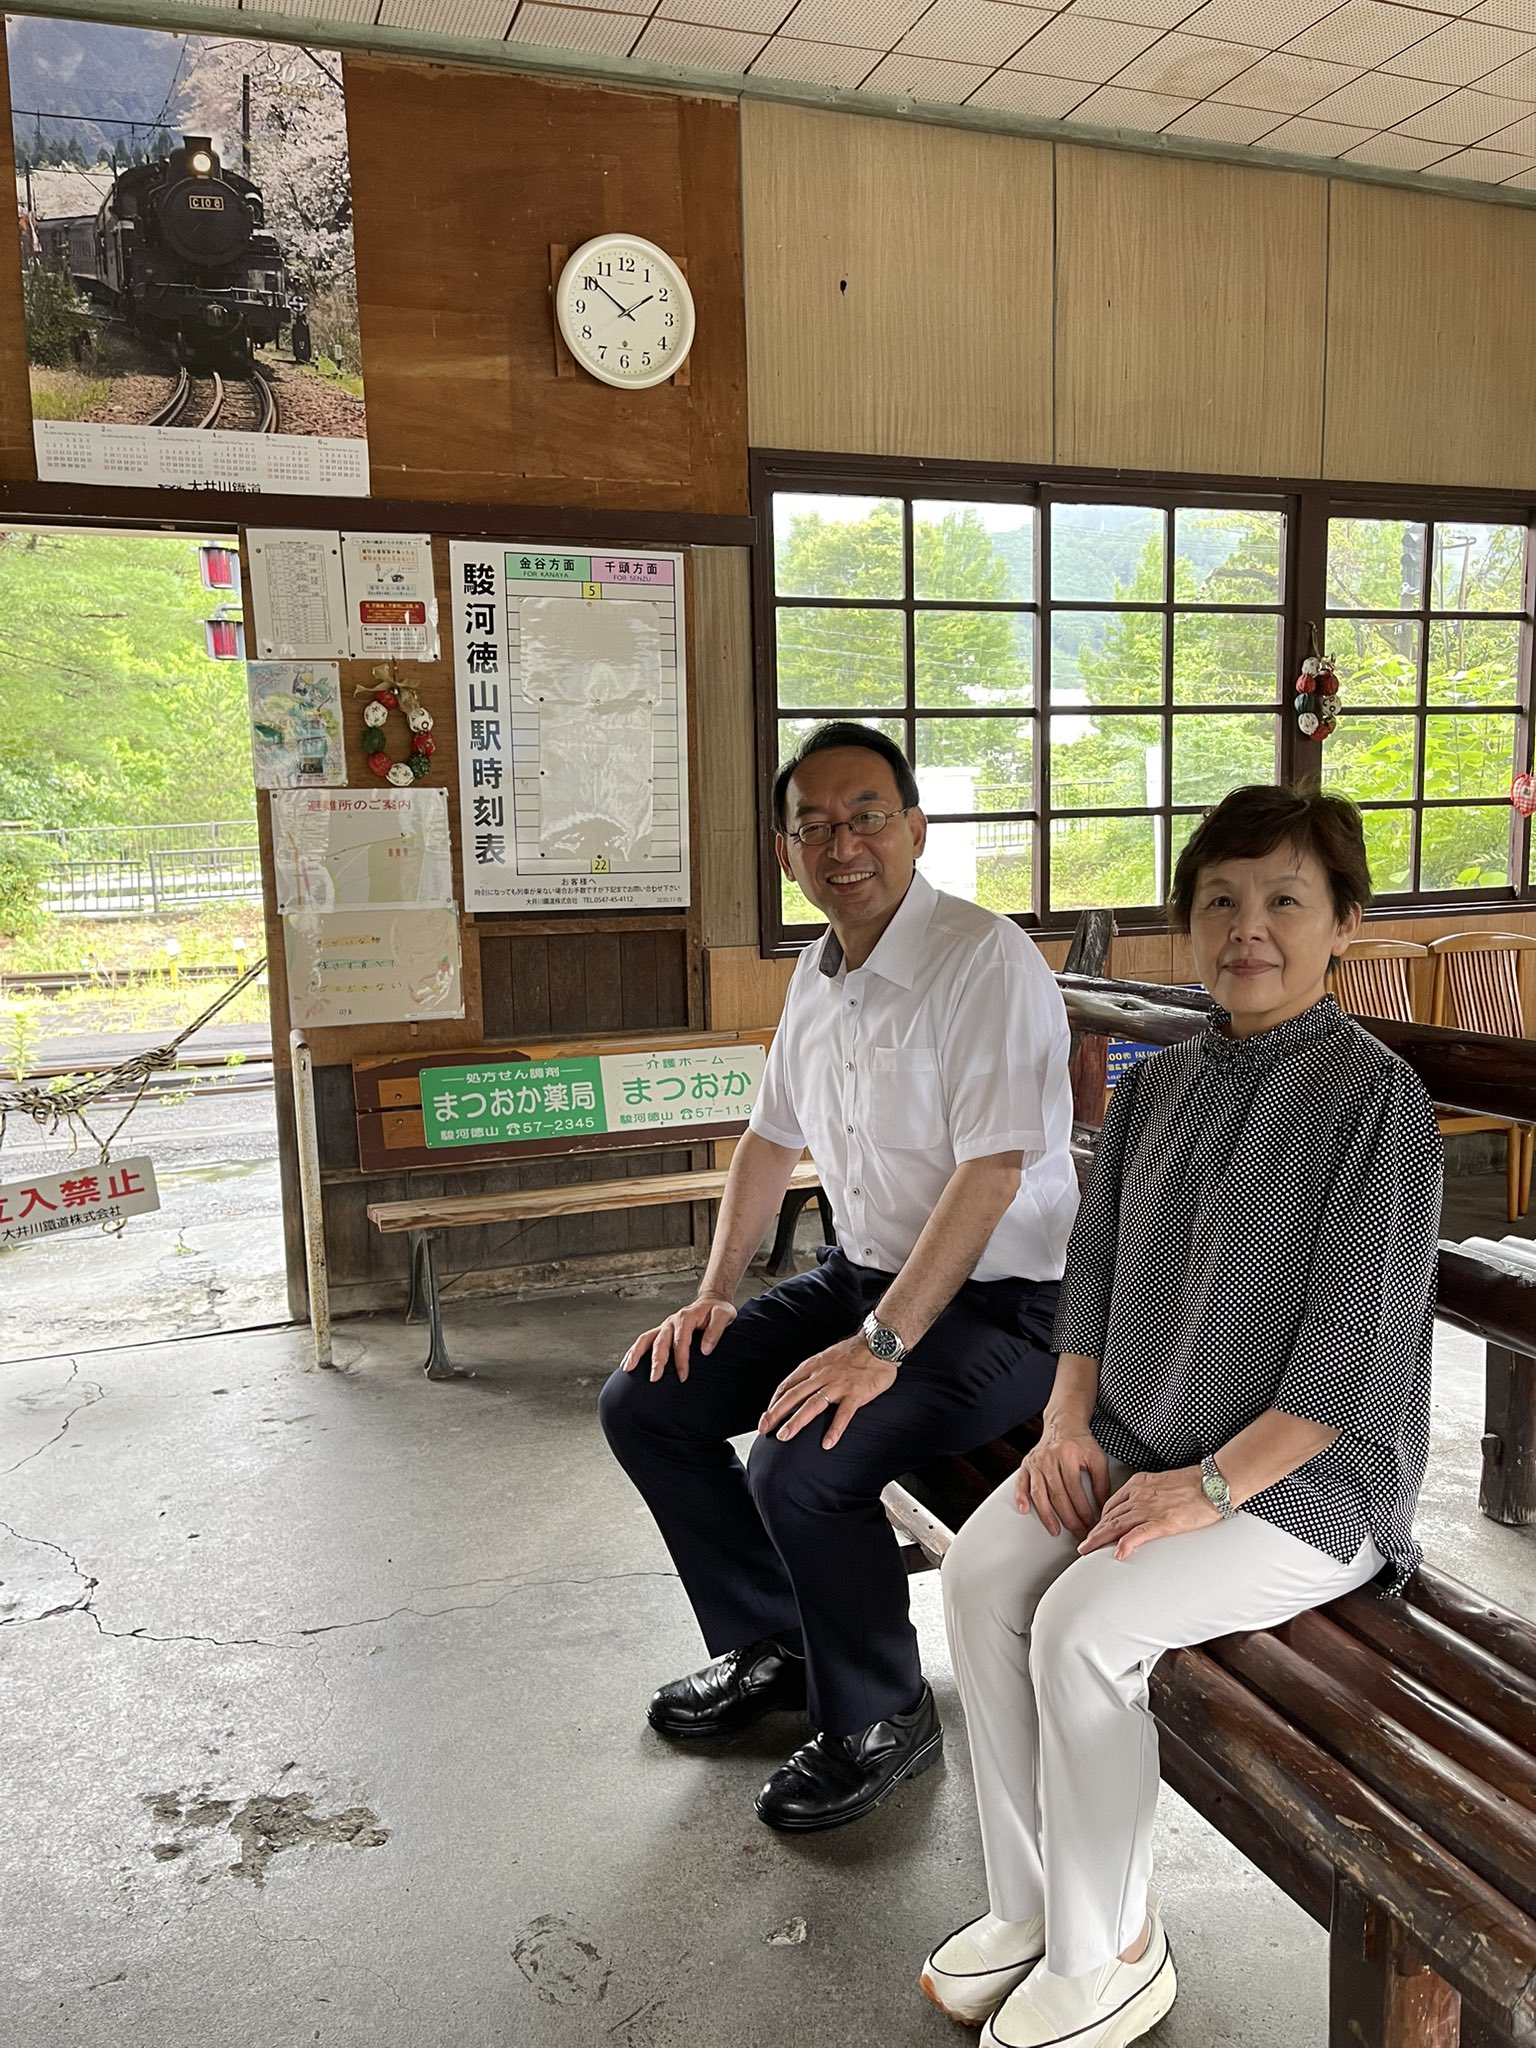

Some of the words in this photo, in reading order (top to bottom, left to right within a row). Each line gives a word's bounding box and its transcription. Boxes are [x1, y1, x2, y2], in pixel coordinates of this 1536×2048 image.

[597, 262, 612, 277] 11
[618, 257, 635, 272] 12
[644, 269, 650, 282] 1
[583, 276, 598, 291] 10
[659, 288, 668, 302] 2
[576, 300, 585, 313] 9
[665, 314, 673, 326] 3
[582, 326, 592, 339] 8
[657, 336, 667, 350] 4
[598, 346, 607, 360] 7
[642, 352, 651, 365] 5
[620, 355, 629, 368] 6
[520, 557, 575, 571] 金谷方面
[605, 561, 658, 574] 千頭方面
[588, 586, 596, 596] 5
[463, 563, 506, 866] 駿河徳山駅時刻表
[307, 799, 412, 812] 避難所のご案内
[594, 860, 606, 871] 22
[561, 878, 596, 886] お客様へ
[645, 1054, 725, 1070] 介護ホーム
[466, 1066, 560, 1084] 処方せん調剤
[622, 1070, 752, 1106] まつおか
[432, 1081, 596, 1123] まつおか薬局
[620, 1110, 674, 1125] 駿河徳山
[695, 1103, 754, 1118] 57-113
[440, 1126, 499, 1141] 駿河徳山
[522, 1116, 595, 1134] 57-2345
[2, 1205, 122, 1242] 大井川鐵道株式会社
